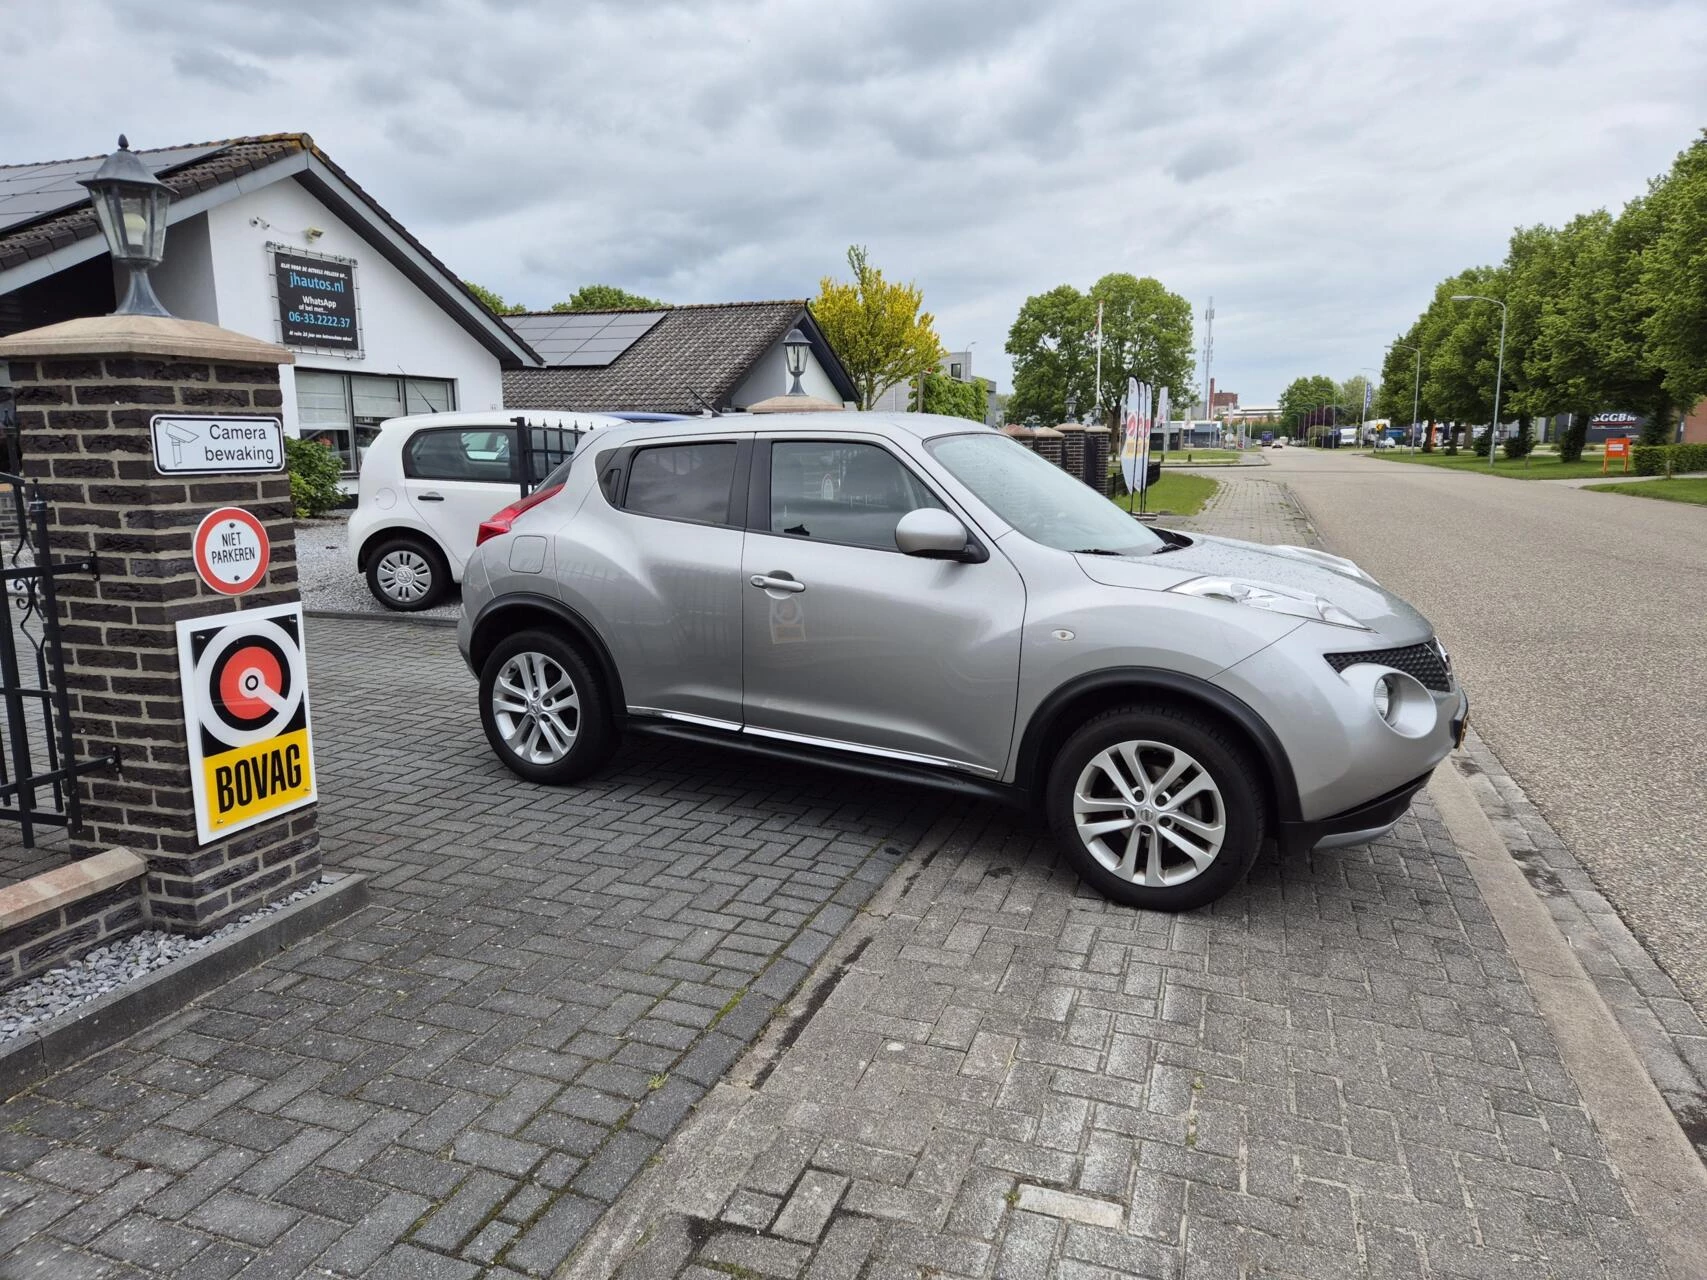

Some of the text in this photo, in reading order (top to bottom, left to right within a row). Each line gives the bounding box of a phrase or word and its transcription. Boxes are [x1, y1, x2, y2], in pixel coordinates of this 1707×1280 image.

[289, 271, 344, 293] jhautos.nl
[302, 295, 337, 309] WhatsApp
[288, 311, 351, 328] 06-33.2222.37
[1591, 413, 1627, 422] SGGB
[209, 424, 267, 440] Camera
[204, 446, 274, 464] bewaking
[221, 531, 242, 547] NIET
[211, 546, 256, 565] PARKEREN
[215, 743, 302, 814] BOVAG
